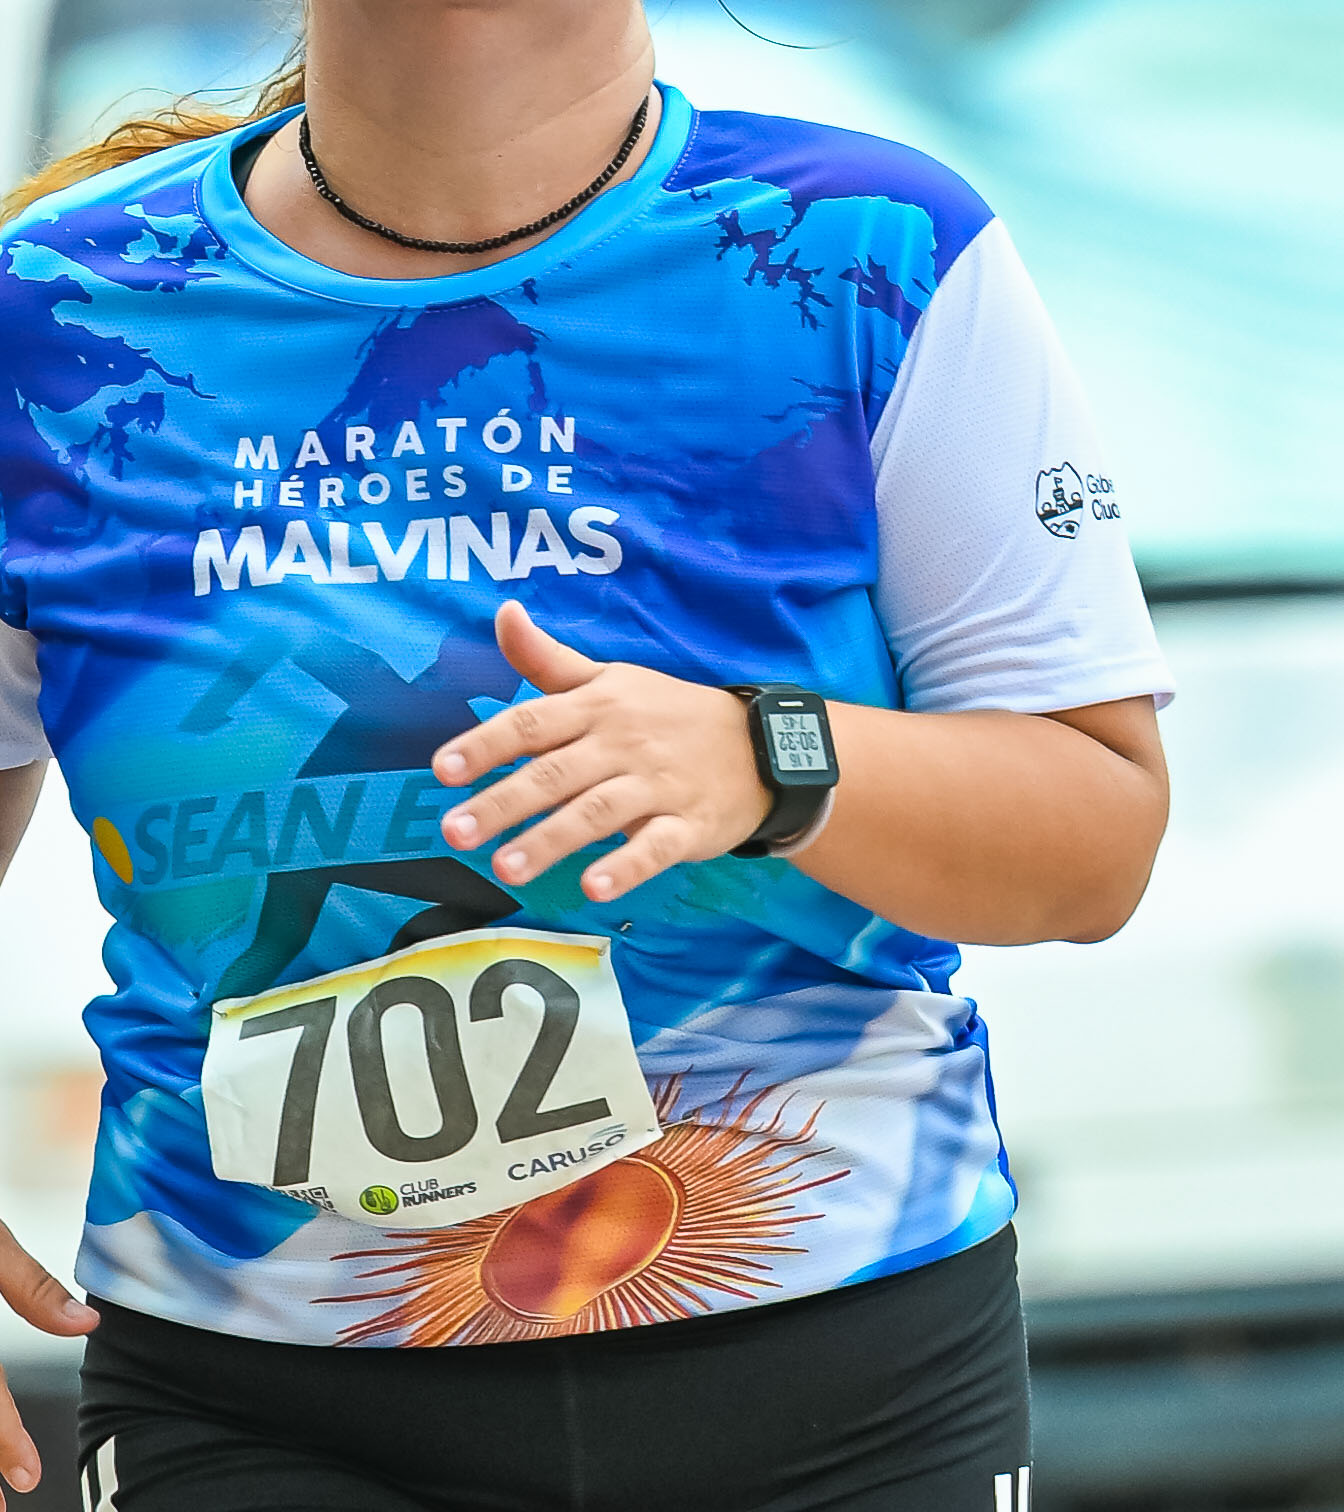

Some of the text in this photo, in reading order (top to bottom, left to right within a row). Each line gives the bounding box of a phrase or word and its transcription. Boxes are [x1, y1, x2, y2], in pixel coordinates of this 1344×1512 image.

[235, 409, 575, 470] MARATÓN
[235, 464, 573, 509] HÉROES DE
[193, 506, 623, 597] MALVINAS
[135, 781, 366, 885] SEAN
[239, 959, 612, 1187] 702
[400, 1178, 439, 1196] CLUB
[507, 1132, 625, 1181] CARUSO
